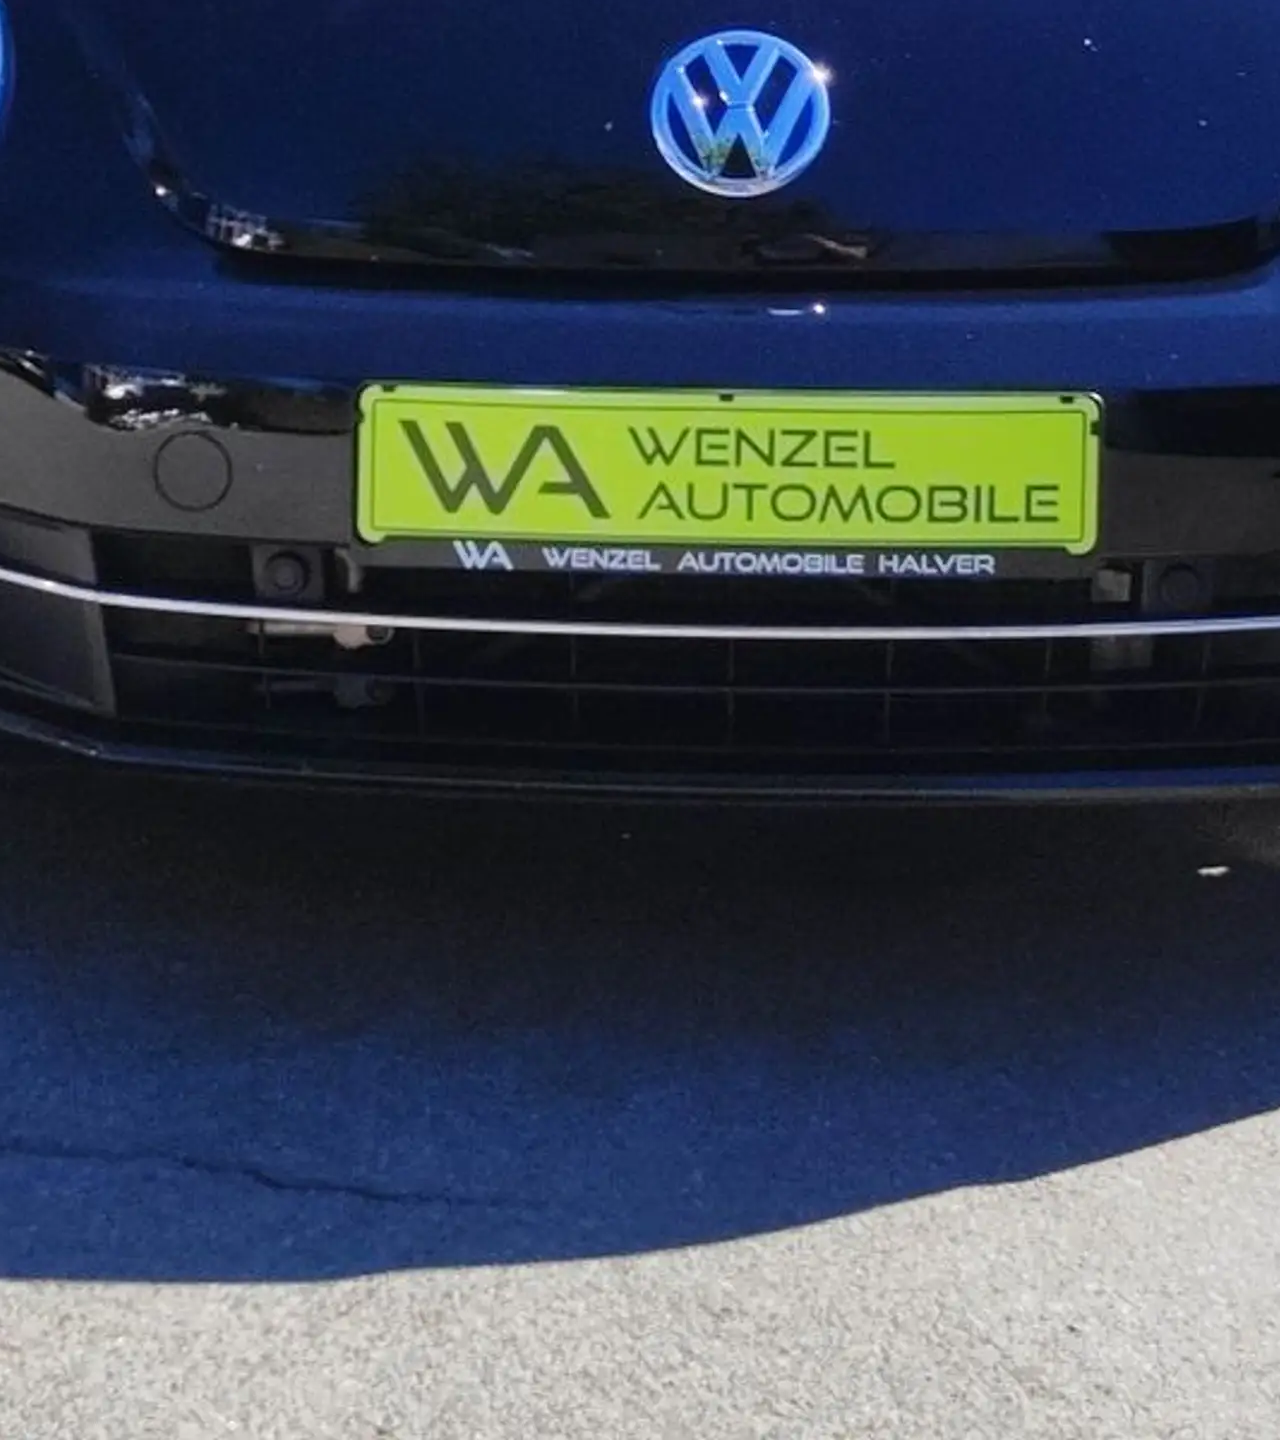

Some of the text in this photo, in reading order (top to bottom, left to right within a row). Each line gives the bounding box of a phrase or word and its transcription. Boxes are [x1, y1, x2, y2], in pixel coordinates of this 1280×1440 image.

[398, 419, 610, 518] WA
[627, 425, 896, 469] WENZEL
[637, 480, 1060, 524] AUTOMOBILE
[451, 539, 997, 576] WA WENZEL AUTOMOBILE HALVER
